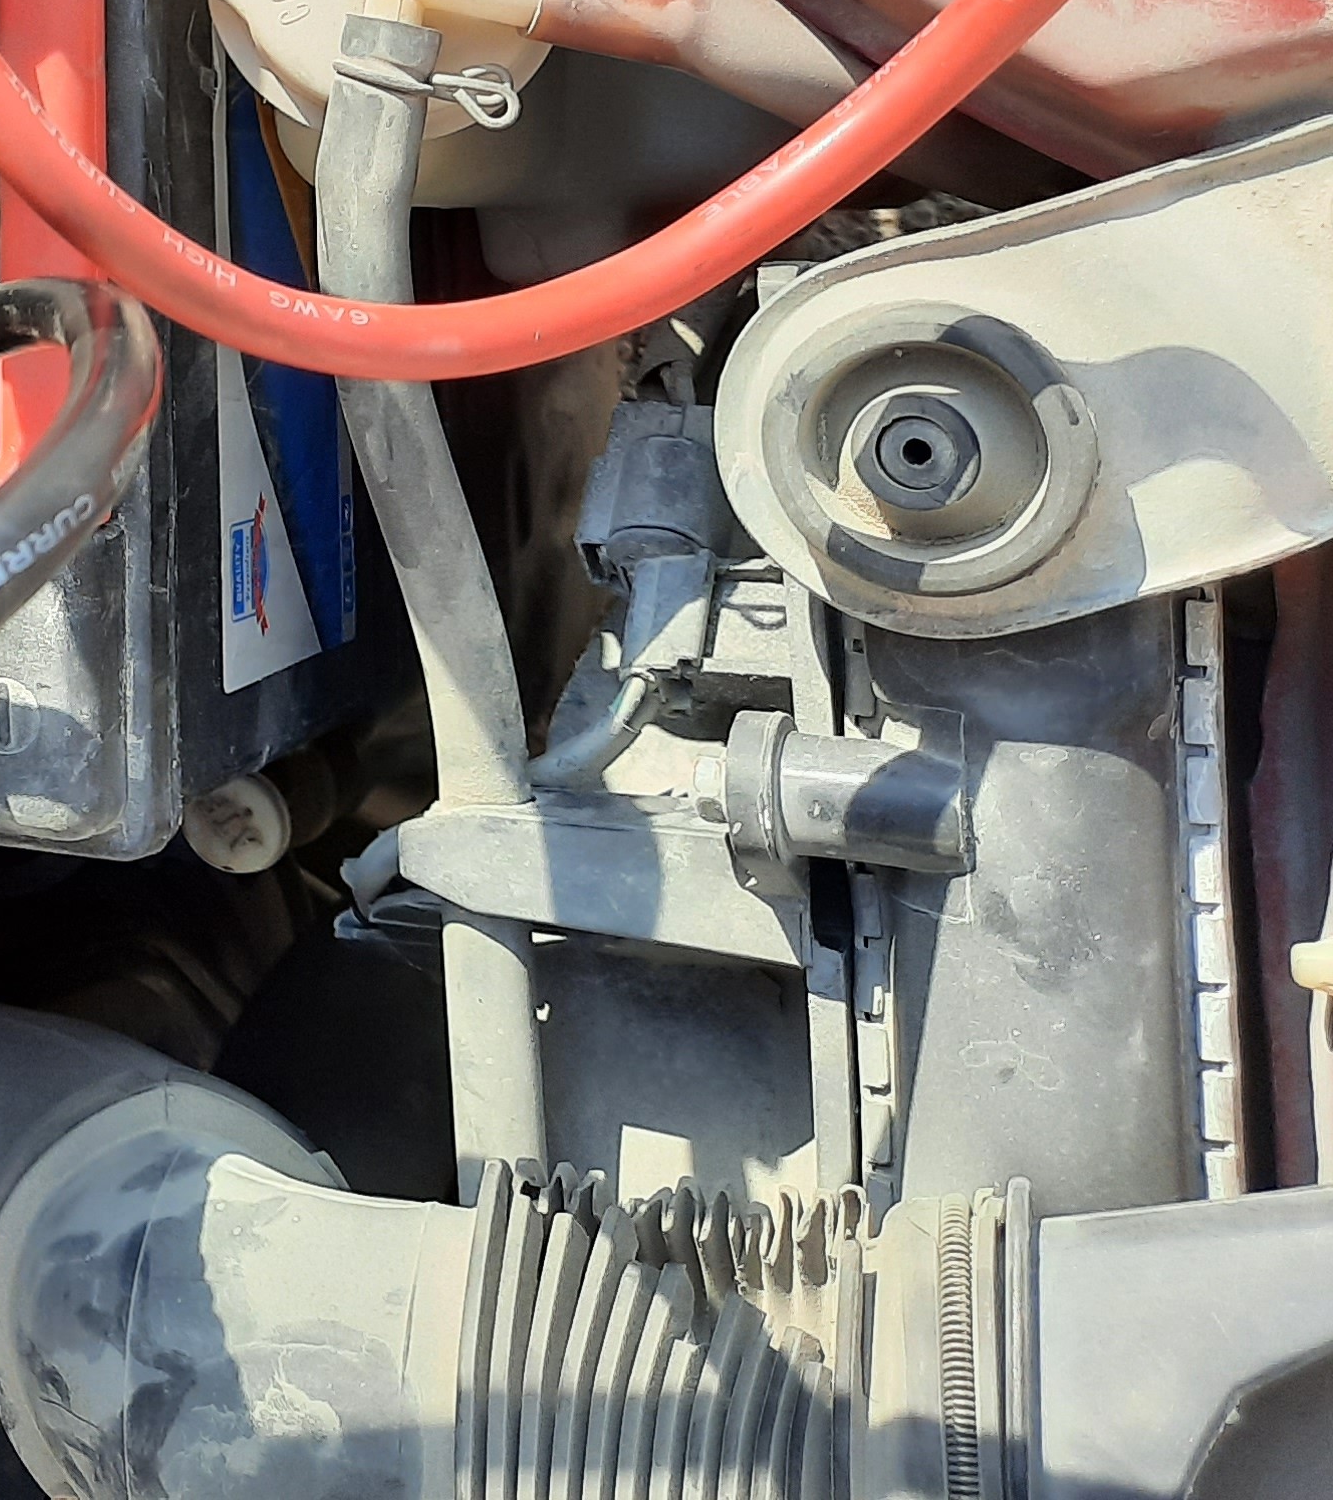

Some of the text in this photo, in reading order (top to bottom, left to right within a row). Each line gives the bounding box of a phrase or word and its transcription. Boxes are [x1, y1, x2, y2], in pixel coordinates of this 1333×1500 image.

[6, 71, 138, 216] CURRENT
[696, 138, 808, 222] CABLE
[161, 229, 239, 289] HIGH
